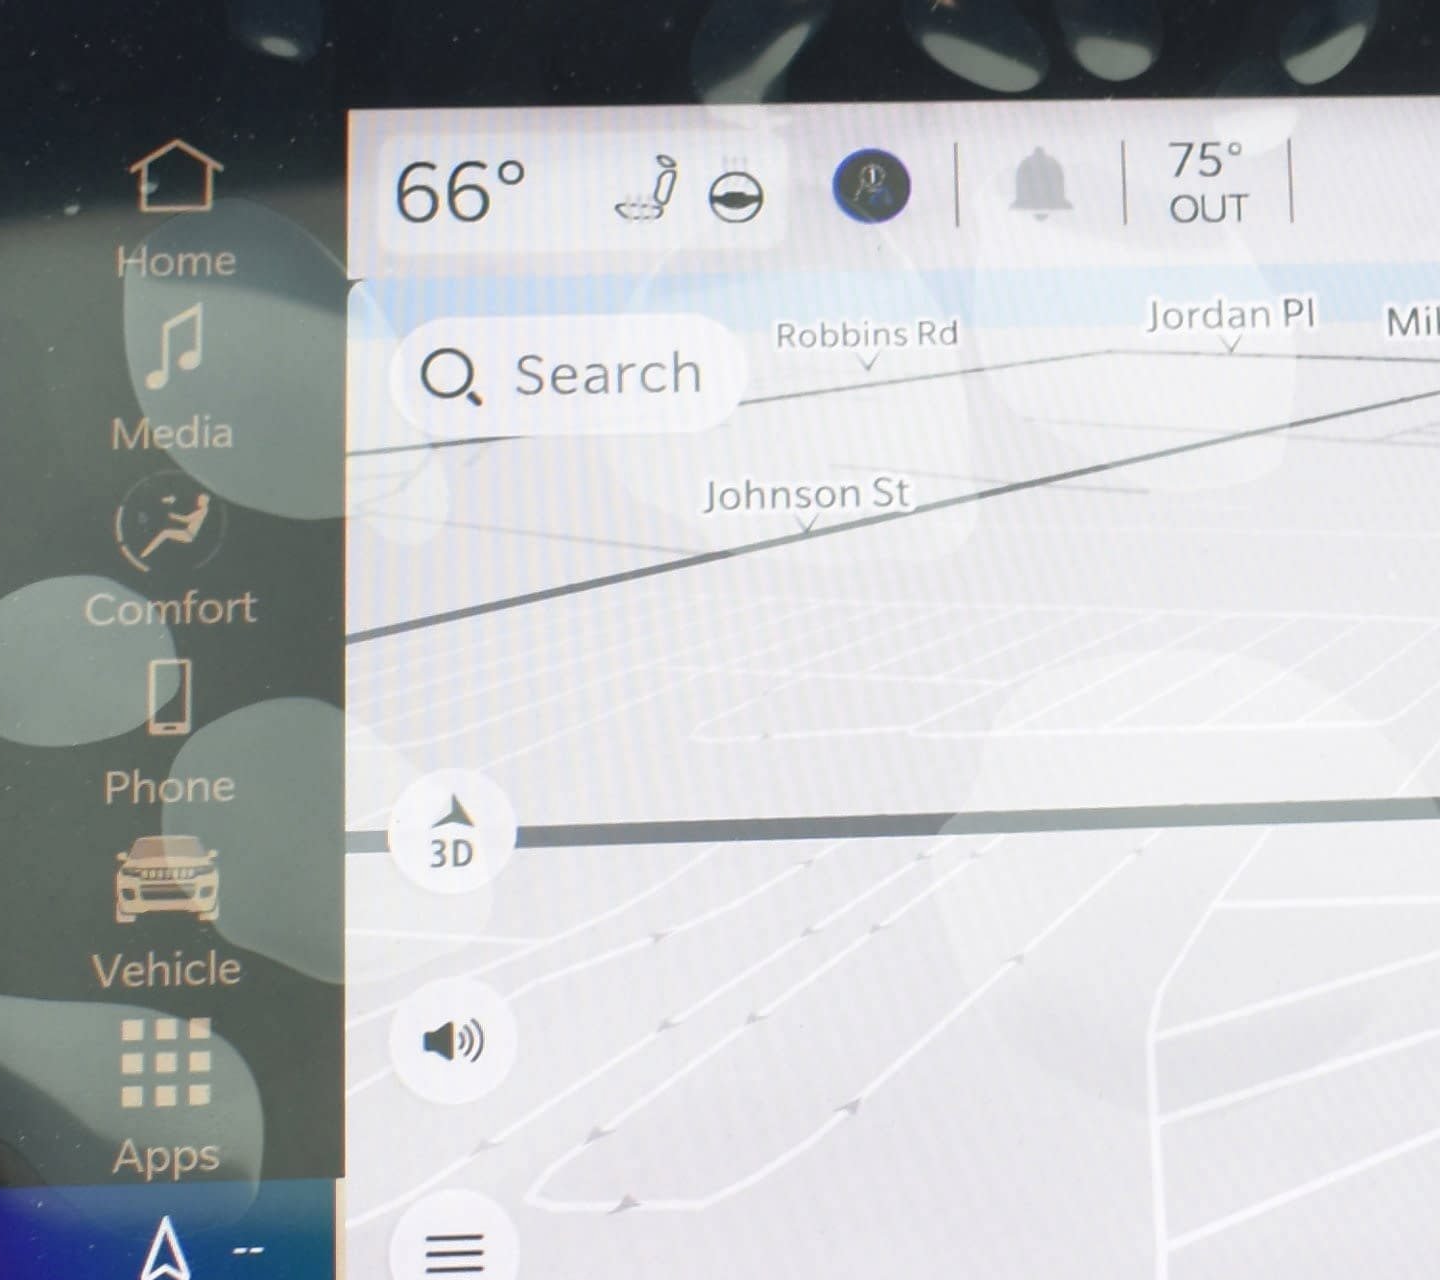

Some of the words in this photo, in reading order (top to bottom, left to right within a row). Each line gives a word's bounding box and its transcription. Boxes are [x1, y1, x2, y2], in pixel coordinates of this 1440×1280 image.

[1169, 141, 1243, 179] 75°
[396, 158, 526, 224] 66°
[1169, 192, 1250, 225] OUT
[117, 245, 237, 277] Home
[1147, 299, 1270, 333] Jordan
[1283, 297, 1315, 327] Pl
[776, 320, 909, 349] Robbins
[917, 320, 958, 346] Rd
[515, 350, 702, 397] Search
[111, 416, 234, 451] Media
[703, 478, 861, 516] Johnson
[873, 476, 910, 508] St
[84, 591, 259, 627] Comfort
[104, 769, 236, 805] Phone
[430, 838, 474, 869] 3D
[90, 951, 241, 988] Vehicle
[112, 1138, 221, 1182] Apps
